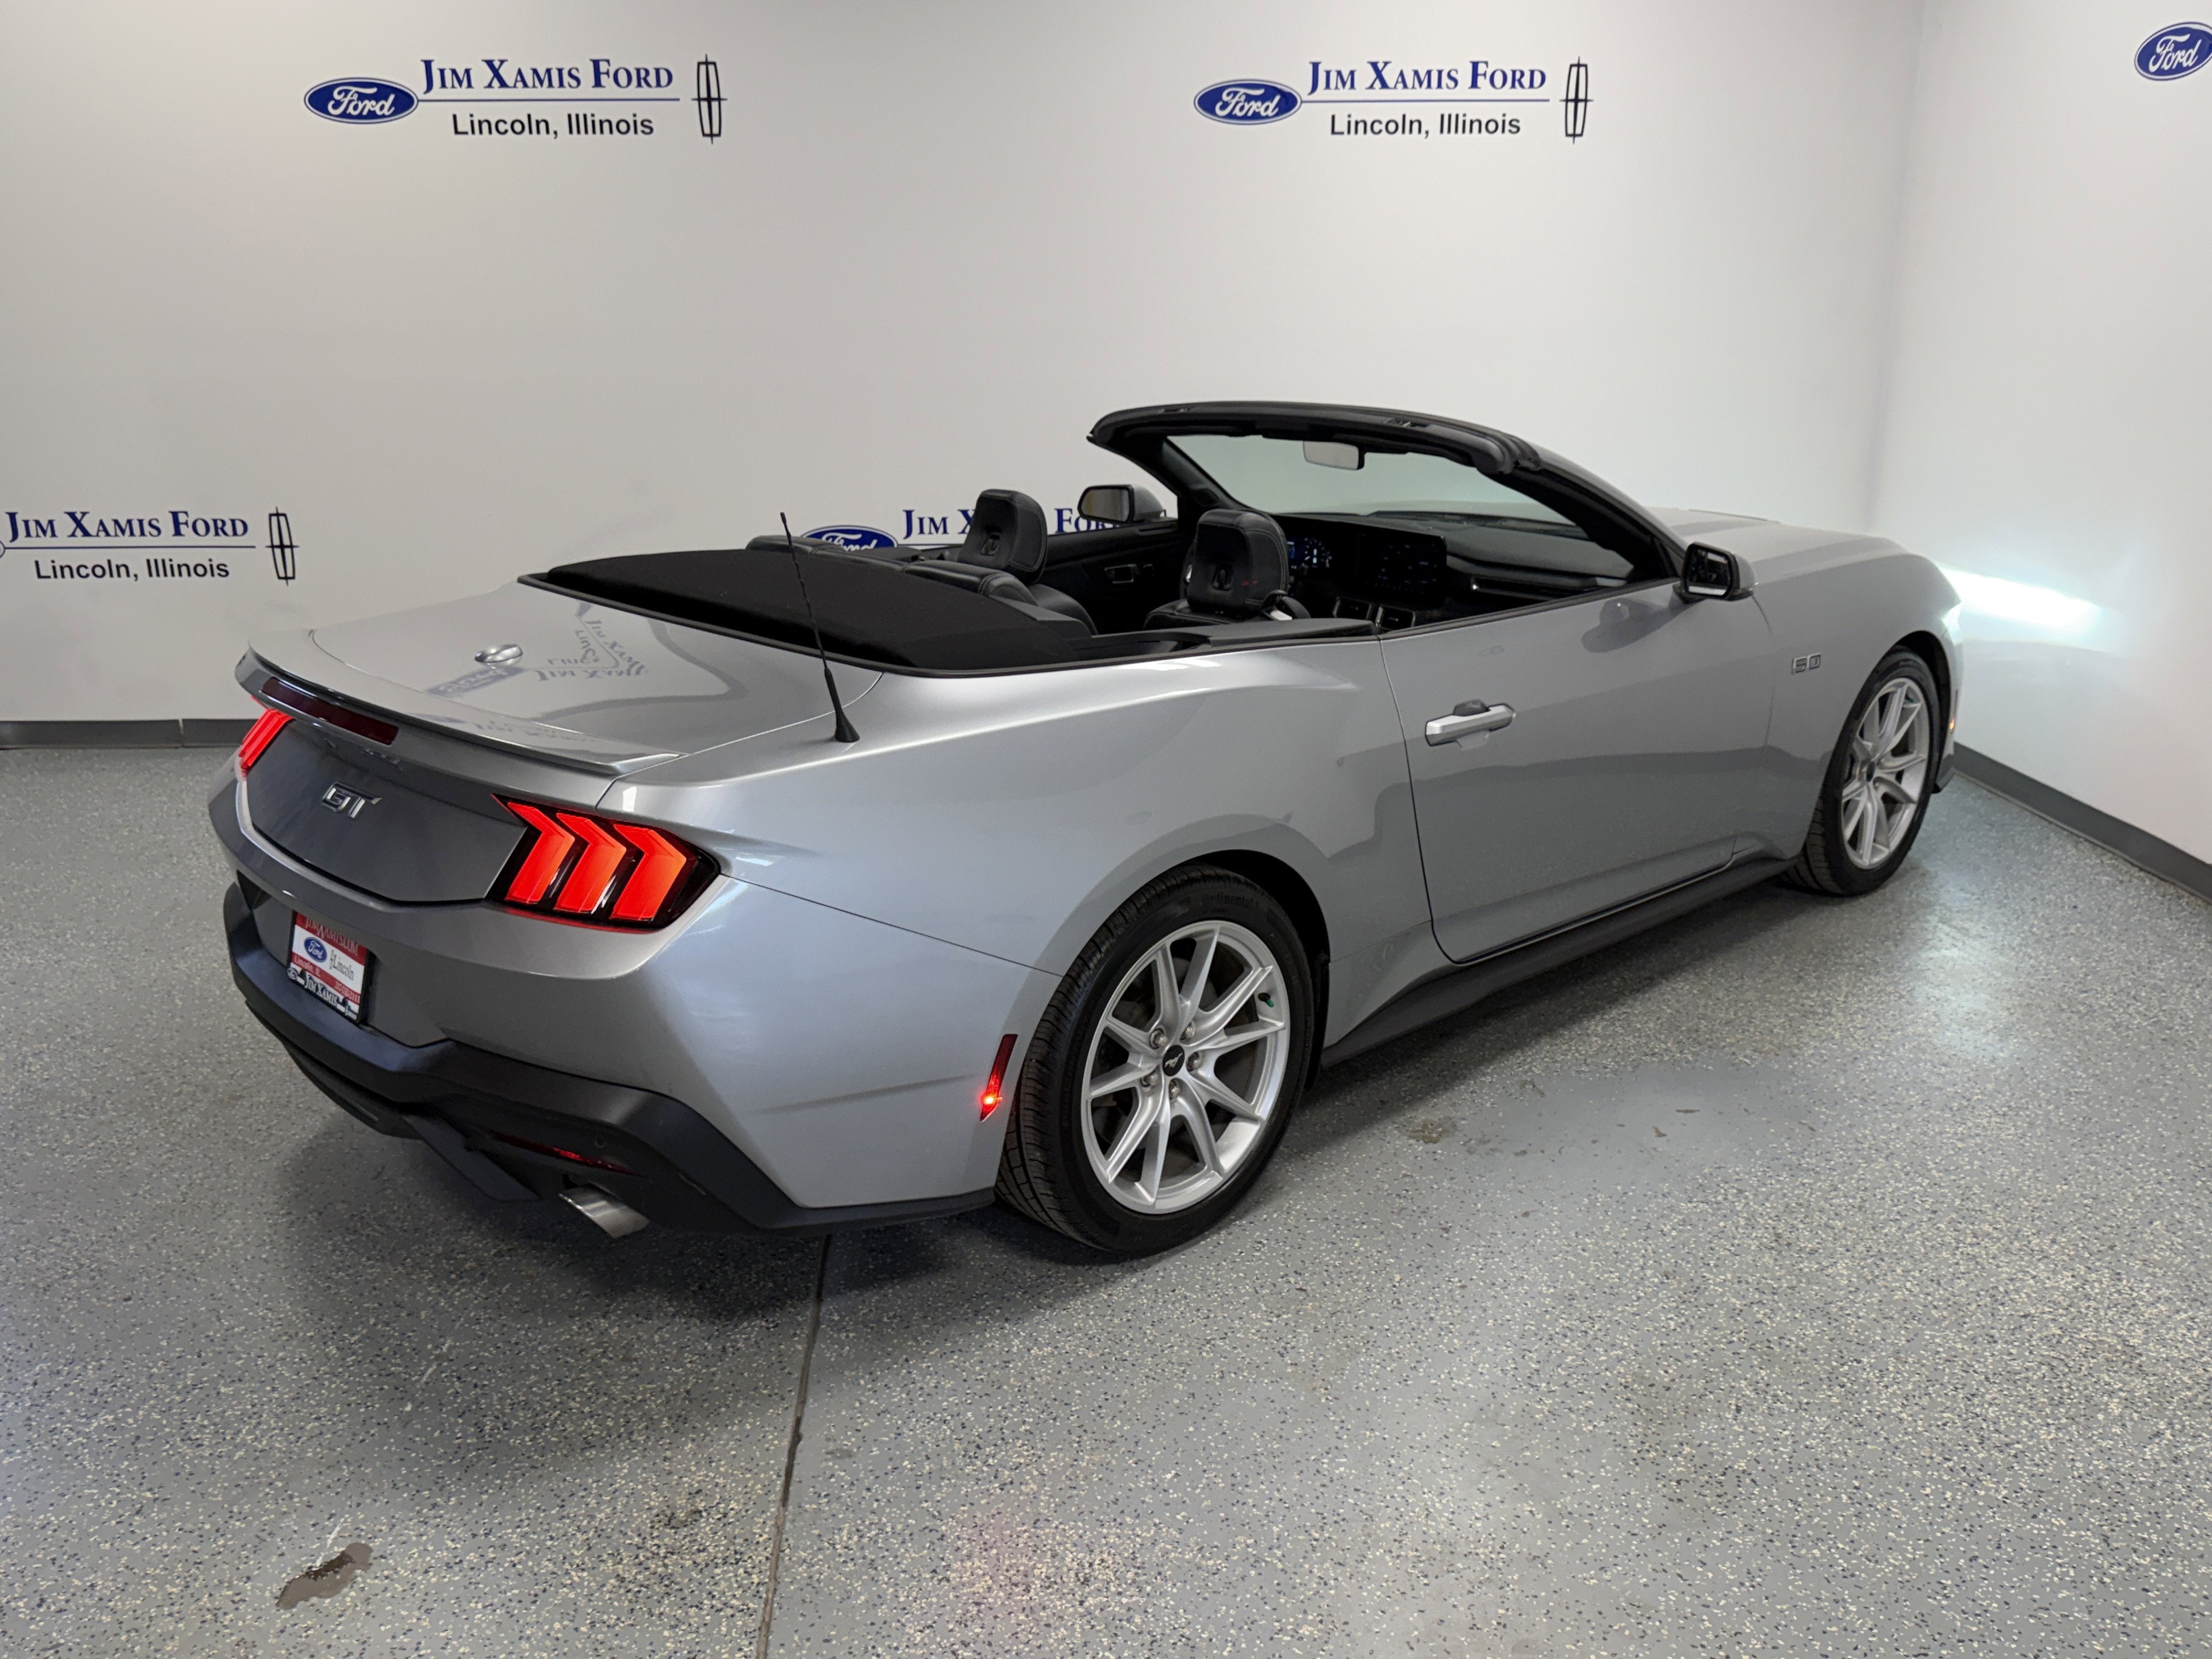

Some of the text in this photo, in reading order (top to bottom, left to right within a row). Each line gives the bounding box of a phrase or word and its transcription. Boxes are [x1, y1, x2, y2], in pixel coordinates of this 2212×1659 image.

[2148, 33, 2202, 72] Ford
[420, 59, 673, 95] JIM XAMIS FORD
[1307, 61, 1546, 96] JIM XAMIS FORD
[328, 86, 395, 116] Ford
[1215, 87, 1280, 117] Ford
[452, 113, 654, 139] Lincoln, Illinois
[1330, 113, 1521, 139] Lincoln, Illinois
[5, 510, 249, 543] JIM XAMIS FORD
[902, 509, 949, 540] JIM
[34, 558, 230, 582] Lincoln, Illinois
[321, 781, 383, 819] GT
[333, 955, 354, 981] Lincoln
